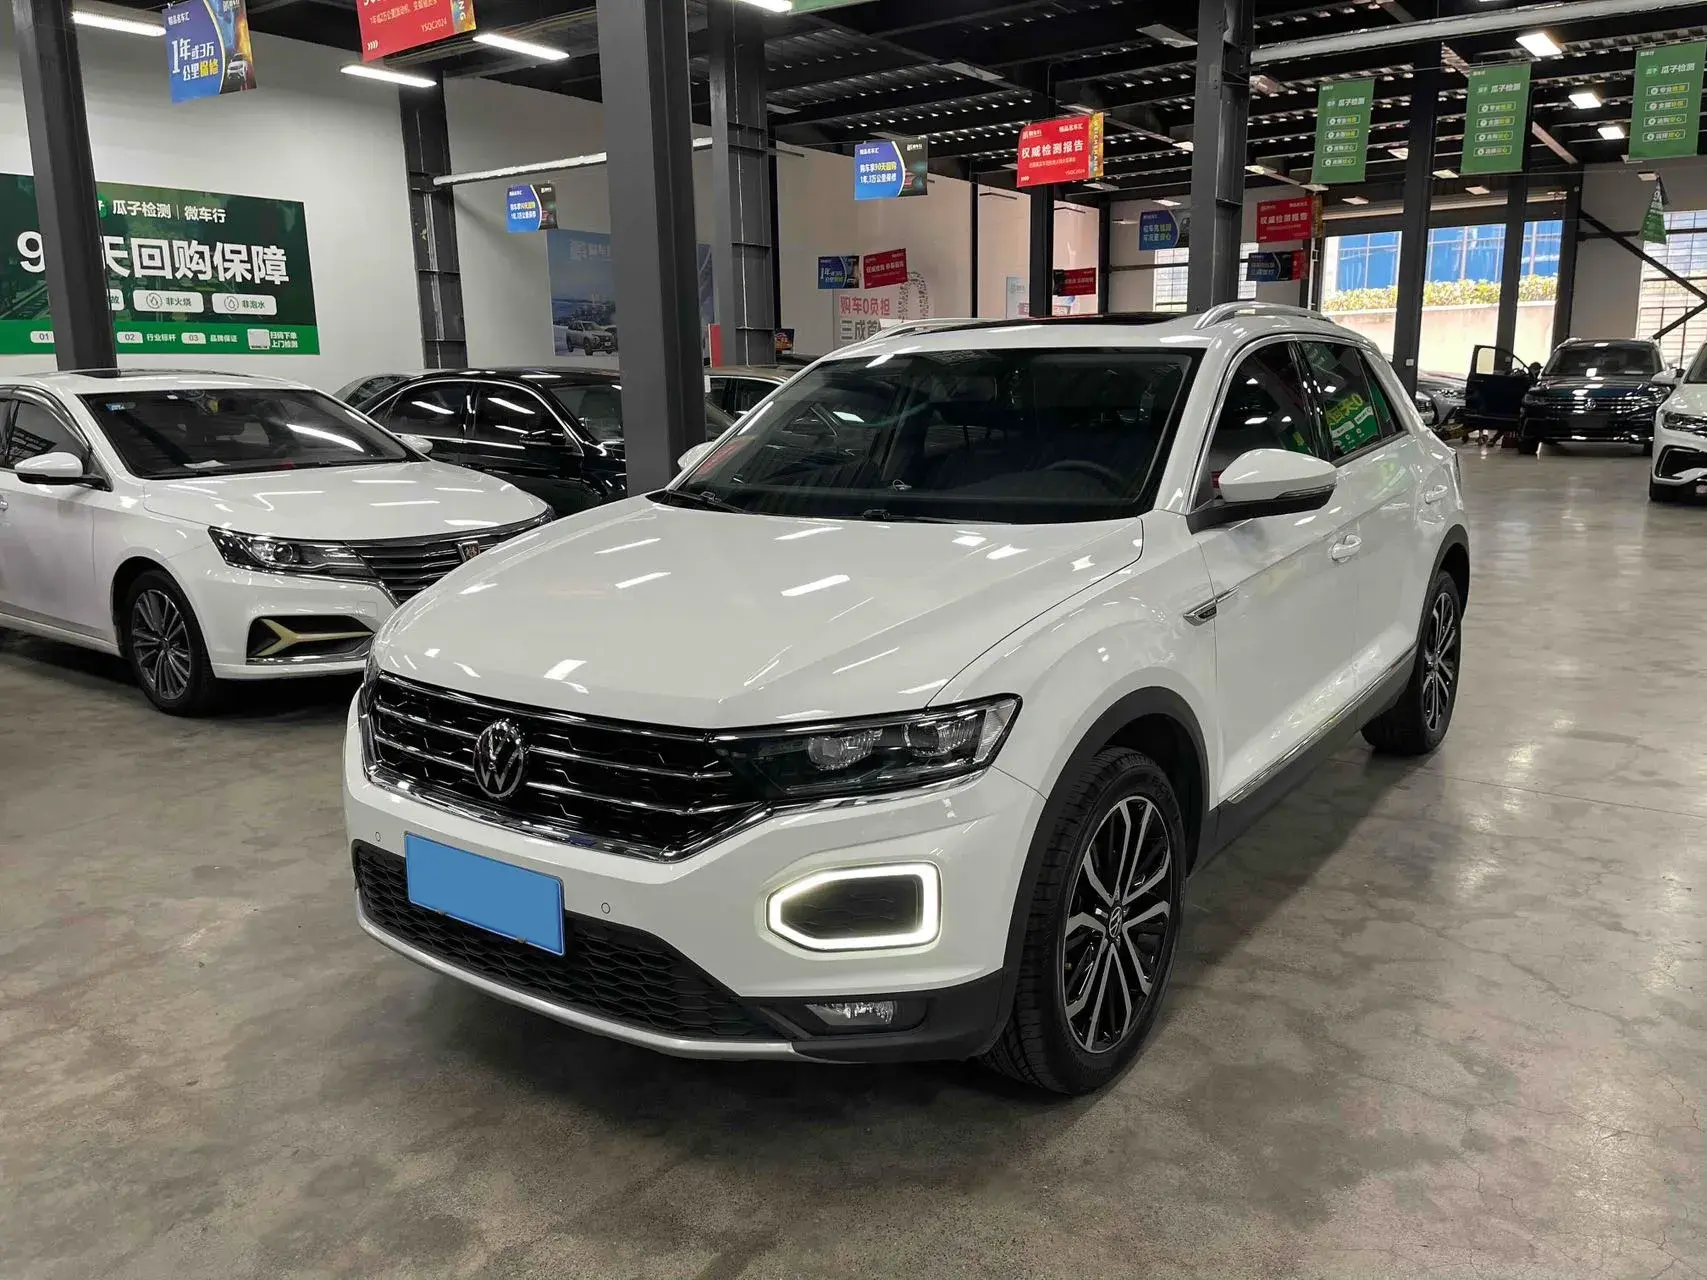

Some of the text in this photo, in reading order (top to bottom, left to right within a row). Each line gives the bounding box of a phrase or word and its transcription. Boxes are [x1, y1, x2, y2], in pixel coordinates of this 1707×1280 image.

[1661, 62, 1696, 74] 瓜子检测
[1021, 139, 1083, 159] 权威检测报告
[112, 201, 171, 218] 瓜子检测
[184, 206, 226, 223] 微车行
[165, 296, 191, 307] 非火烧
[242, 299, 266, 309] 非泡水
[840, 296, 891, 316] 购车0负担
[38, 333, 50, 341] 01
[124, 333, 136, 341] 02
[146, 333, 177, 343] 行业标杆
[188, 334, 199, 342] 03
[270, 330, 298, 340] 扫码下单
